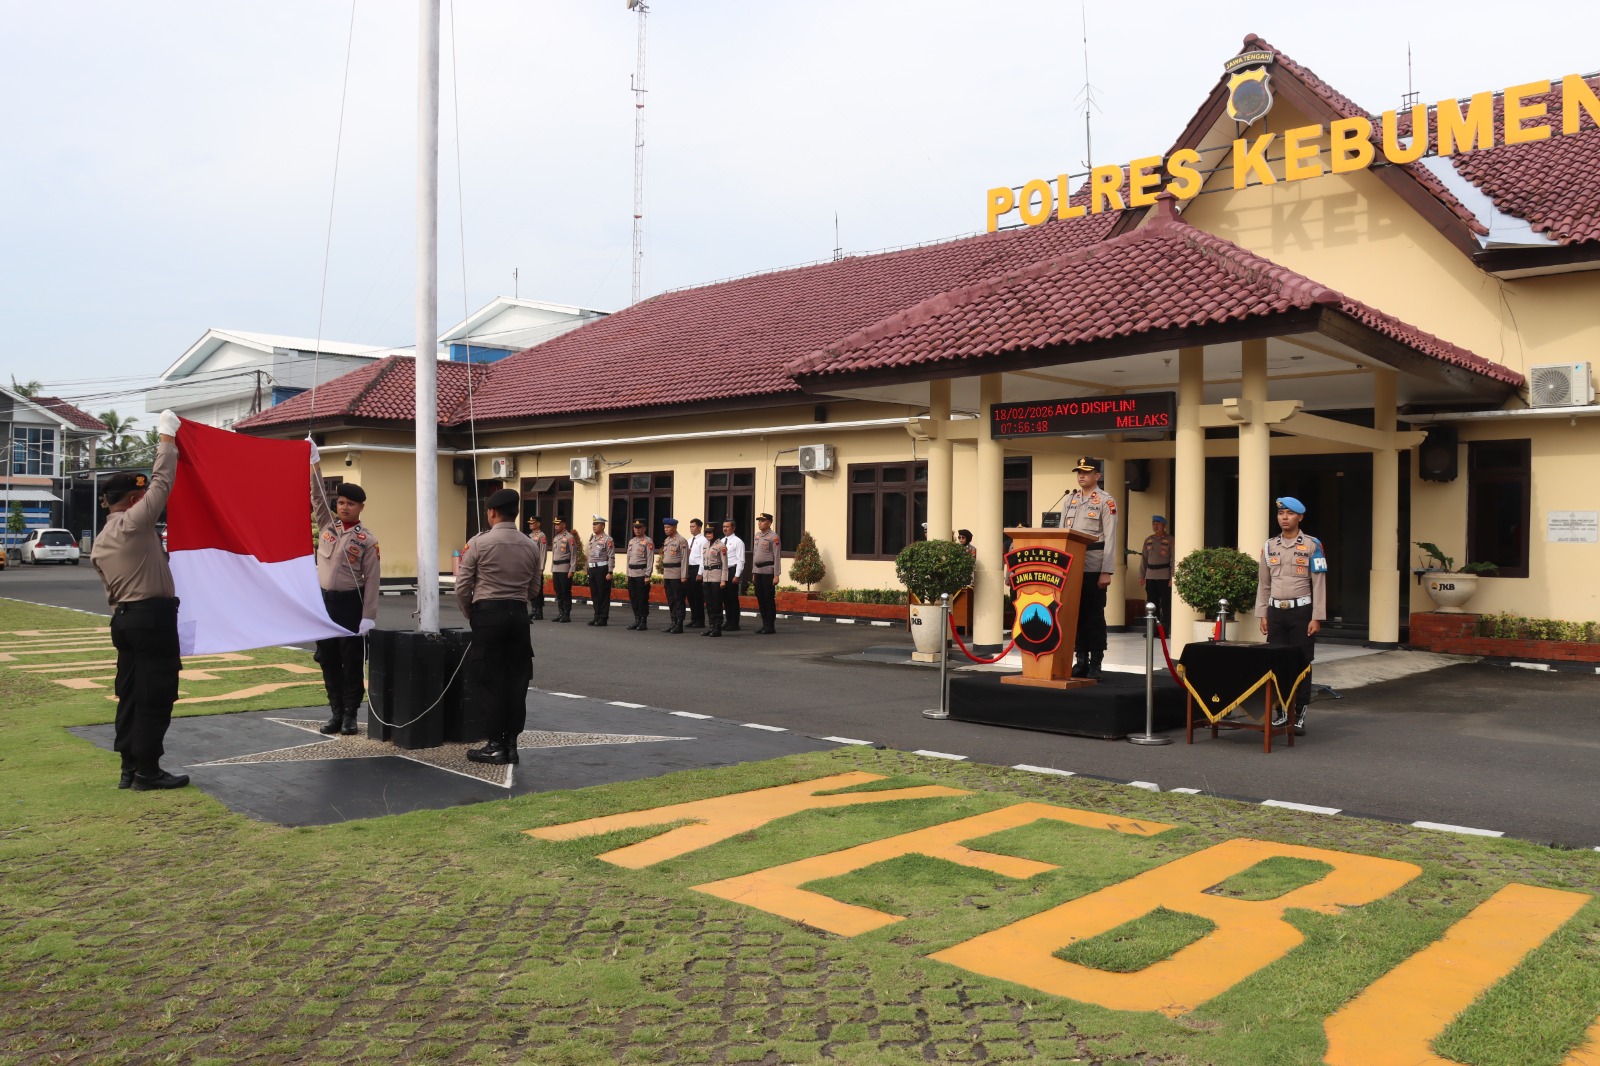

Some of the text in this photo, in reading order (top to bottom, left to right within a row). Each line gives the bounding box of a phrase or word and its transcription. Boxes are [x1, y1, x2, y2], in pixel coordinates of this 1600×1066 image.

[1226, 53, 1270, 69] JAWA TENGAH
[986, 73, 1600, 233] POLRES KEBUMEN
[994, 399, 1136, 421] 18/02/2026 AYO DISIPLIN!
[1000, 413, 1169, 434] 07:56:48 MELAKS
[1016, 549, 1059, 558] POLRES
[1017, 556, 1058, 564] KEBUMEN
[1015, 572, 1060, 586] JAWA TENGAH
[1438, 583, 1455, 591] JKB
